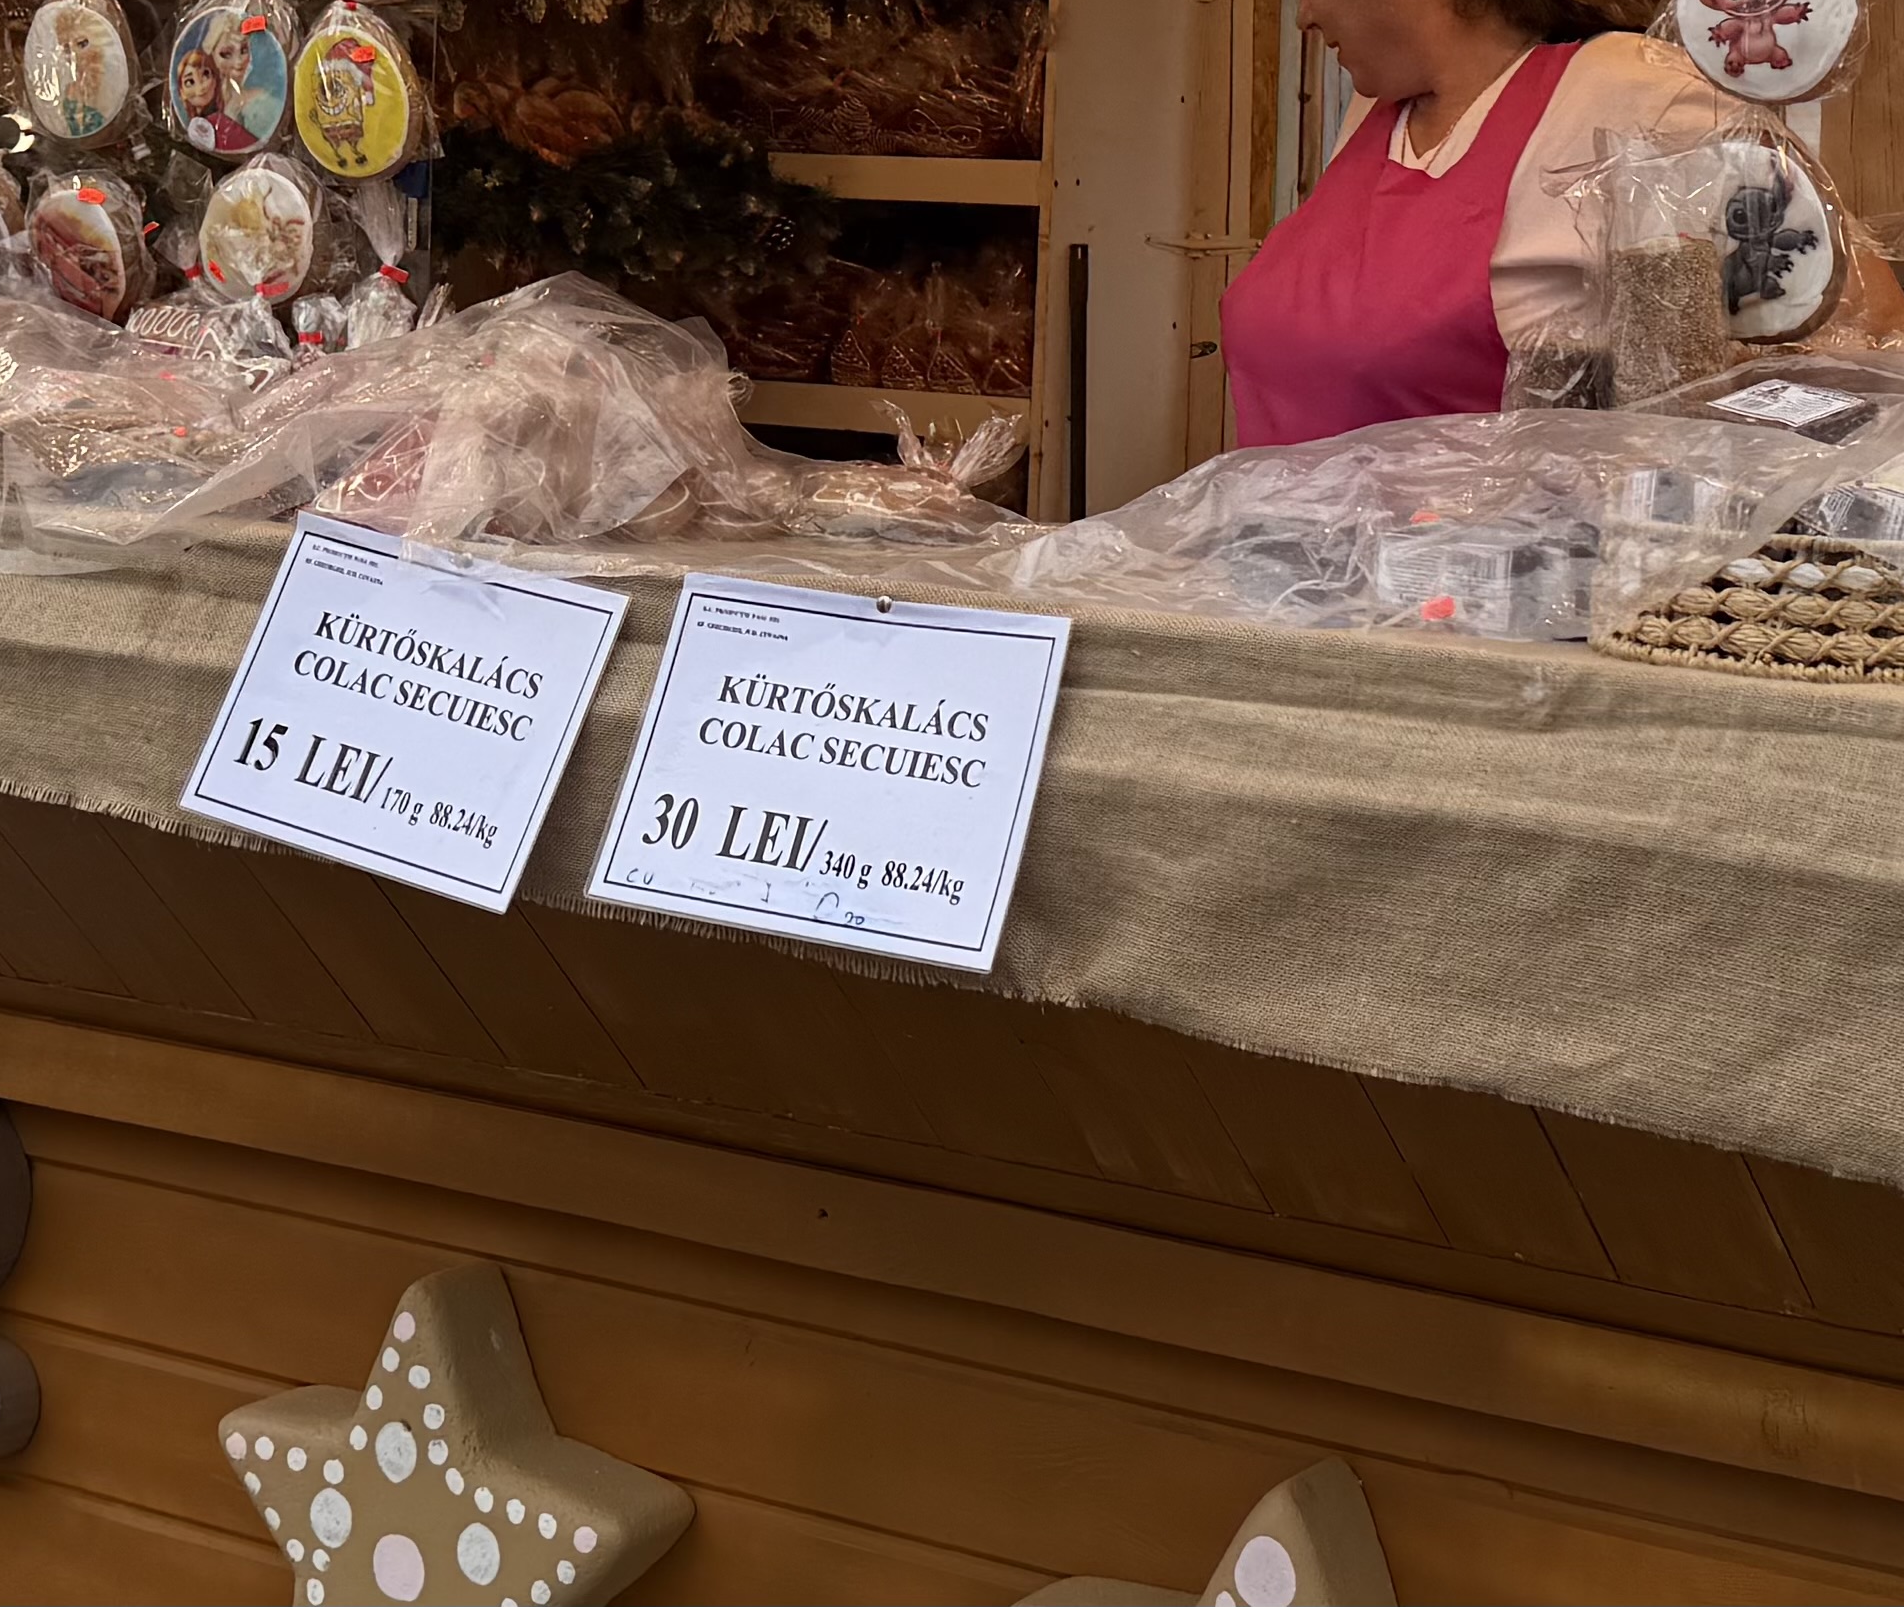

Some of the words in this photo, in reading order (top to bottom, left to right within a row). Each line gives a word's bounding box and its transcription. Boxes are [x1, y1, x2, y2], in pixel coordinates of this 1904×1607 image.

[293, 649, 394, 700] COLAC
[392, 679, 534, 742] SECUIESC
[312, 610, 544, 700] KÜRTŐSKALÁCS
[698, 717, 816, 761] COLAC
[818, 736, 987, 789] SECUIESC
[716, 672, 990, 743] KÜRTŐSKALÁCS
[233, 717, 289, 772] 15
[407, 802, 424, 827] g
[429, 801, 498, 850] 88.24/kg
[641, 792, 700, 850] 30
[856, 862, 873, 890] g
[880, 860, 966, 906] 88.24/kg
